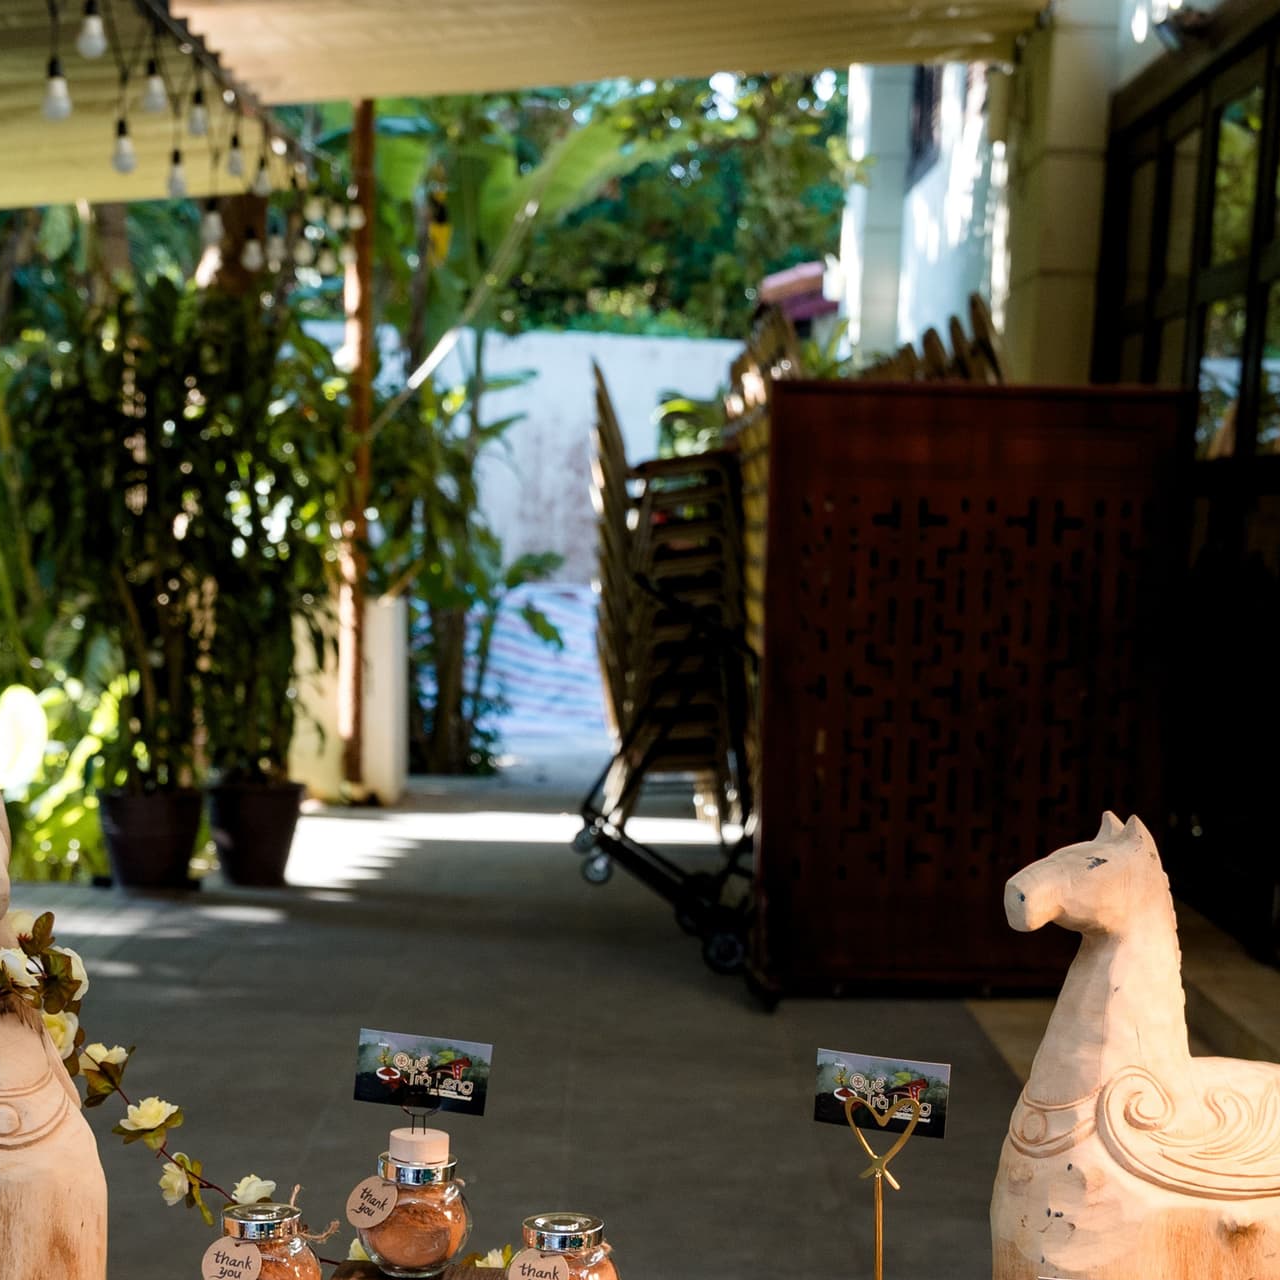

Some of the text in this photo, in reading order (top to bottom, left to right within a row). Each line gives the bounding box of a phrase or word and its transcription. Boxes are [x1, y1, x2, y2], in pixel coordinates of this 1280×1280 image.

[393, 1052, 431, 1072] Quế
[408, 1069, 432, 1087] Trà
[850, 1073, 886, 1094] Quế
[361, 1185, 389, 1212] thank
[351, 1203, 375, 1217] you
[214, 1250, 253, 1270] thank
[212, 1267, 241, 1280] you
[519, 1262, 560, 1280] thank
